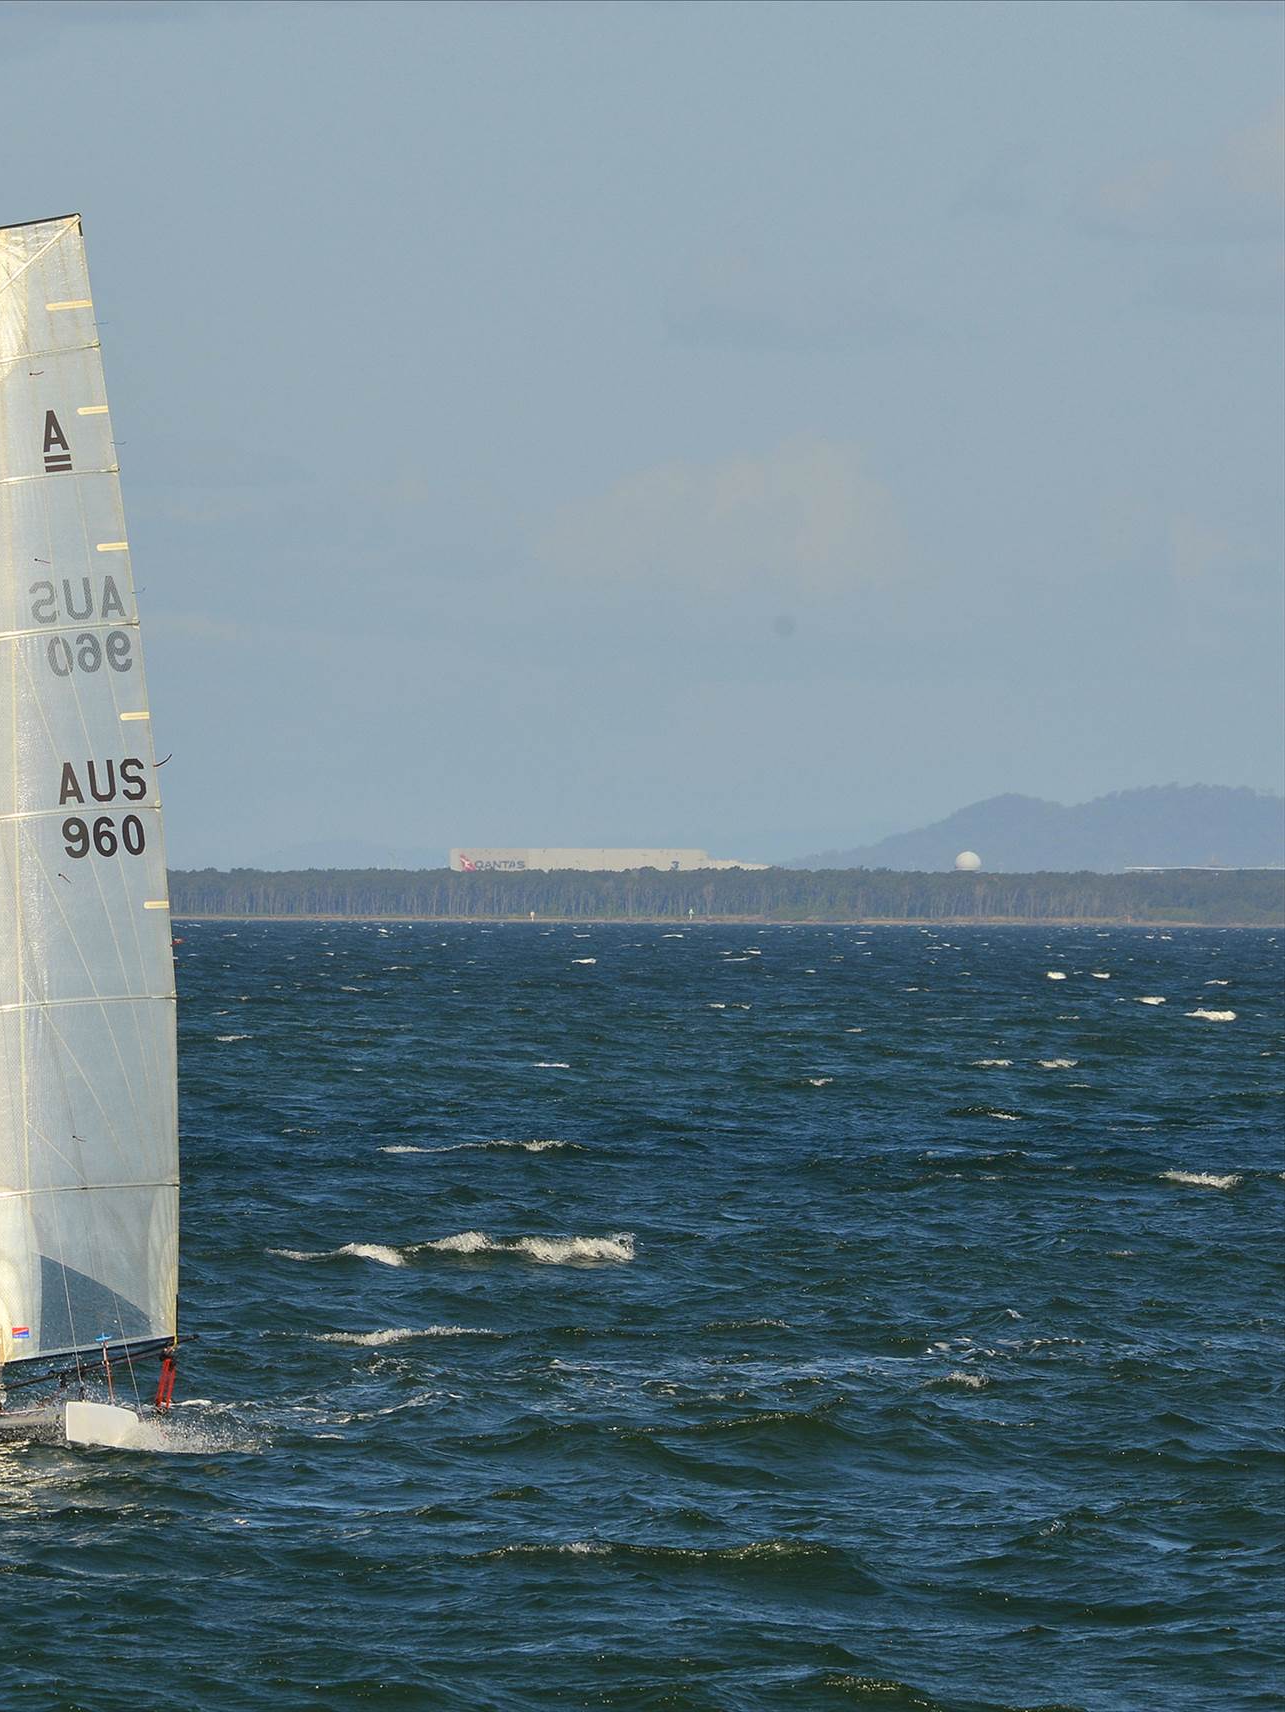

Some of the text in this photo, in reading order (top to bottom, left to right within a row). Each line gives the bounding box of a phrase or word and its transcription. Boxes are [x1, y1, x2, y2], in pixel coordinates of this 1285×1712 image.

[43, 410, 70, 453] A
[59, 758, 147, 805] AUS
[62, 815, 146, 858] 960
[475, 860, 525, 870] QANTAS
